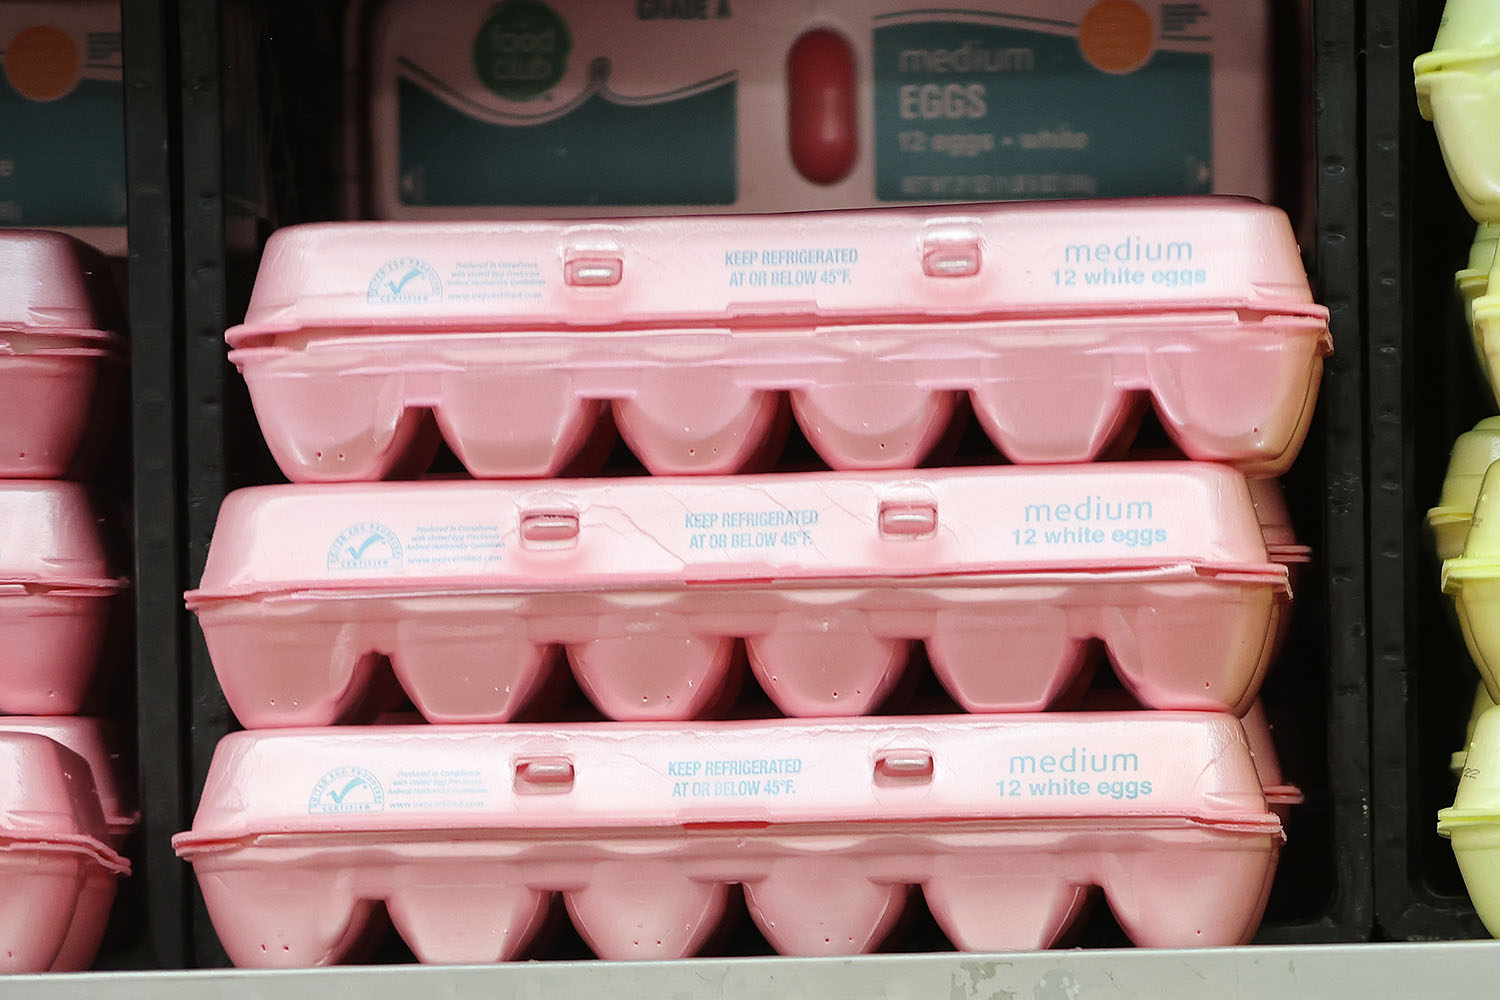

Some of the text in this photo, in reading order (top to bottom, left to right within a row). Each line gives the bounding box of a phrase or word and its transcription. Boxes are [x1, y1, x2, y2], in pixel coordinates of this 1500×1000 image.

[898, 40, 1034, 72] medium
[899, 83, 987, 119] EGGS
[725, 248, 858, 266] KEEP REFRIGERATED
[1065, 236, 1192, 263] medium
[730, 268, 851, 287] AT OR BELOW 45°F.
[1052, 267, 1206, 287] 12 white eggs
[685, 510, 818, 529] KEEP REFRIGERATED
[1025, 496, 1152, 523] medium
[690, 530, 812, 550] AT OR BELOW 45°F.
[1012, 526, 1167, 547] 12 white eggs
[669, 759, 802, 776] KEEP REFRIGERATED
[1010, 747, 1138, 774] medium
[673, 779, 795, 797] AT OR BELOW 45°F.
[996, 778, 1152, 800] 12 white eggs
